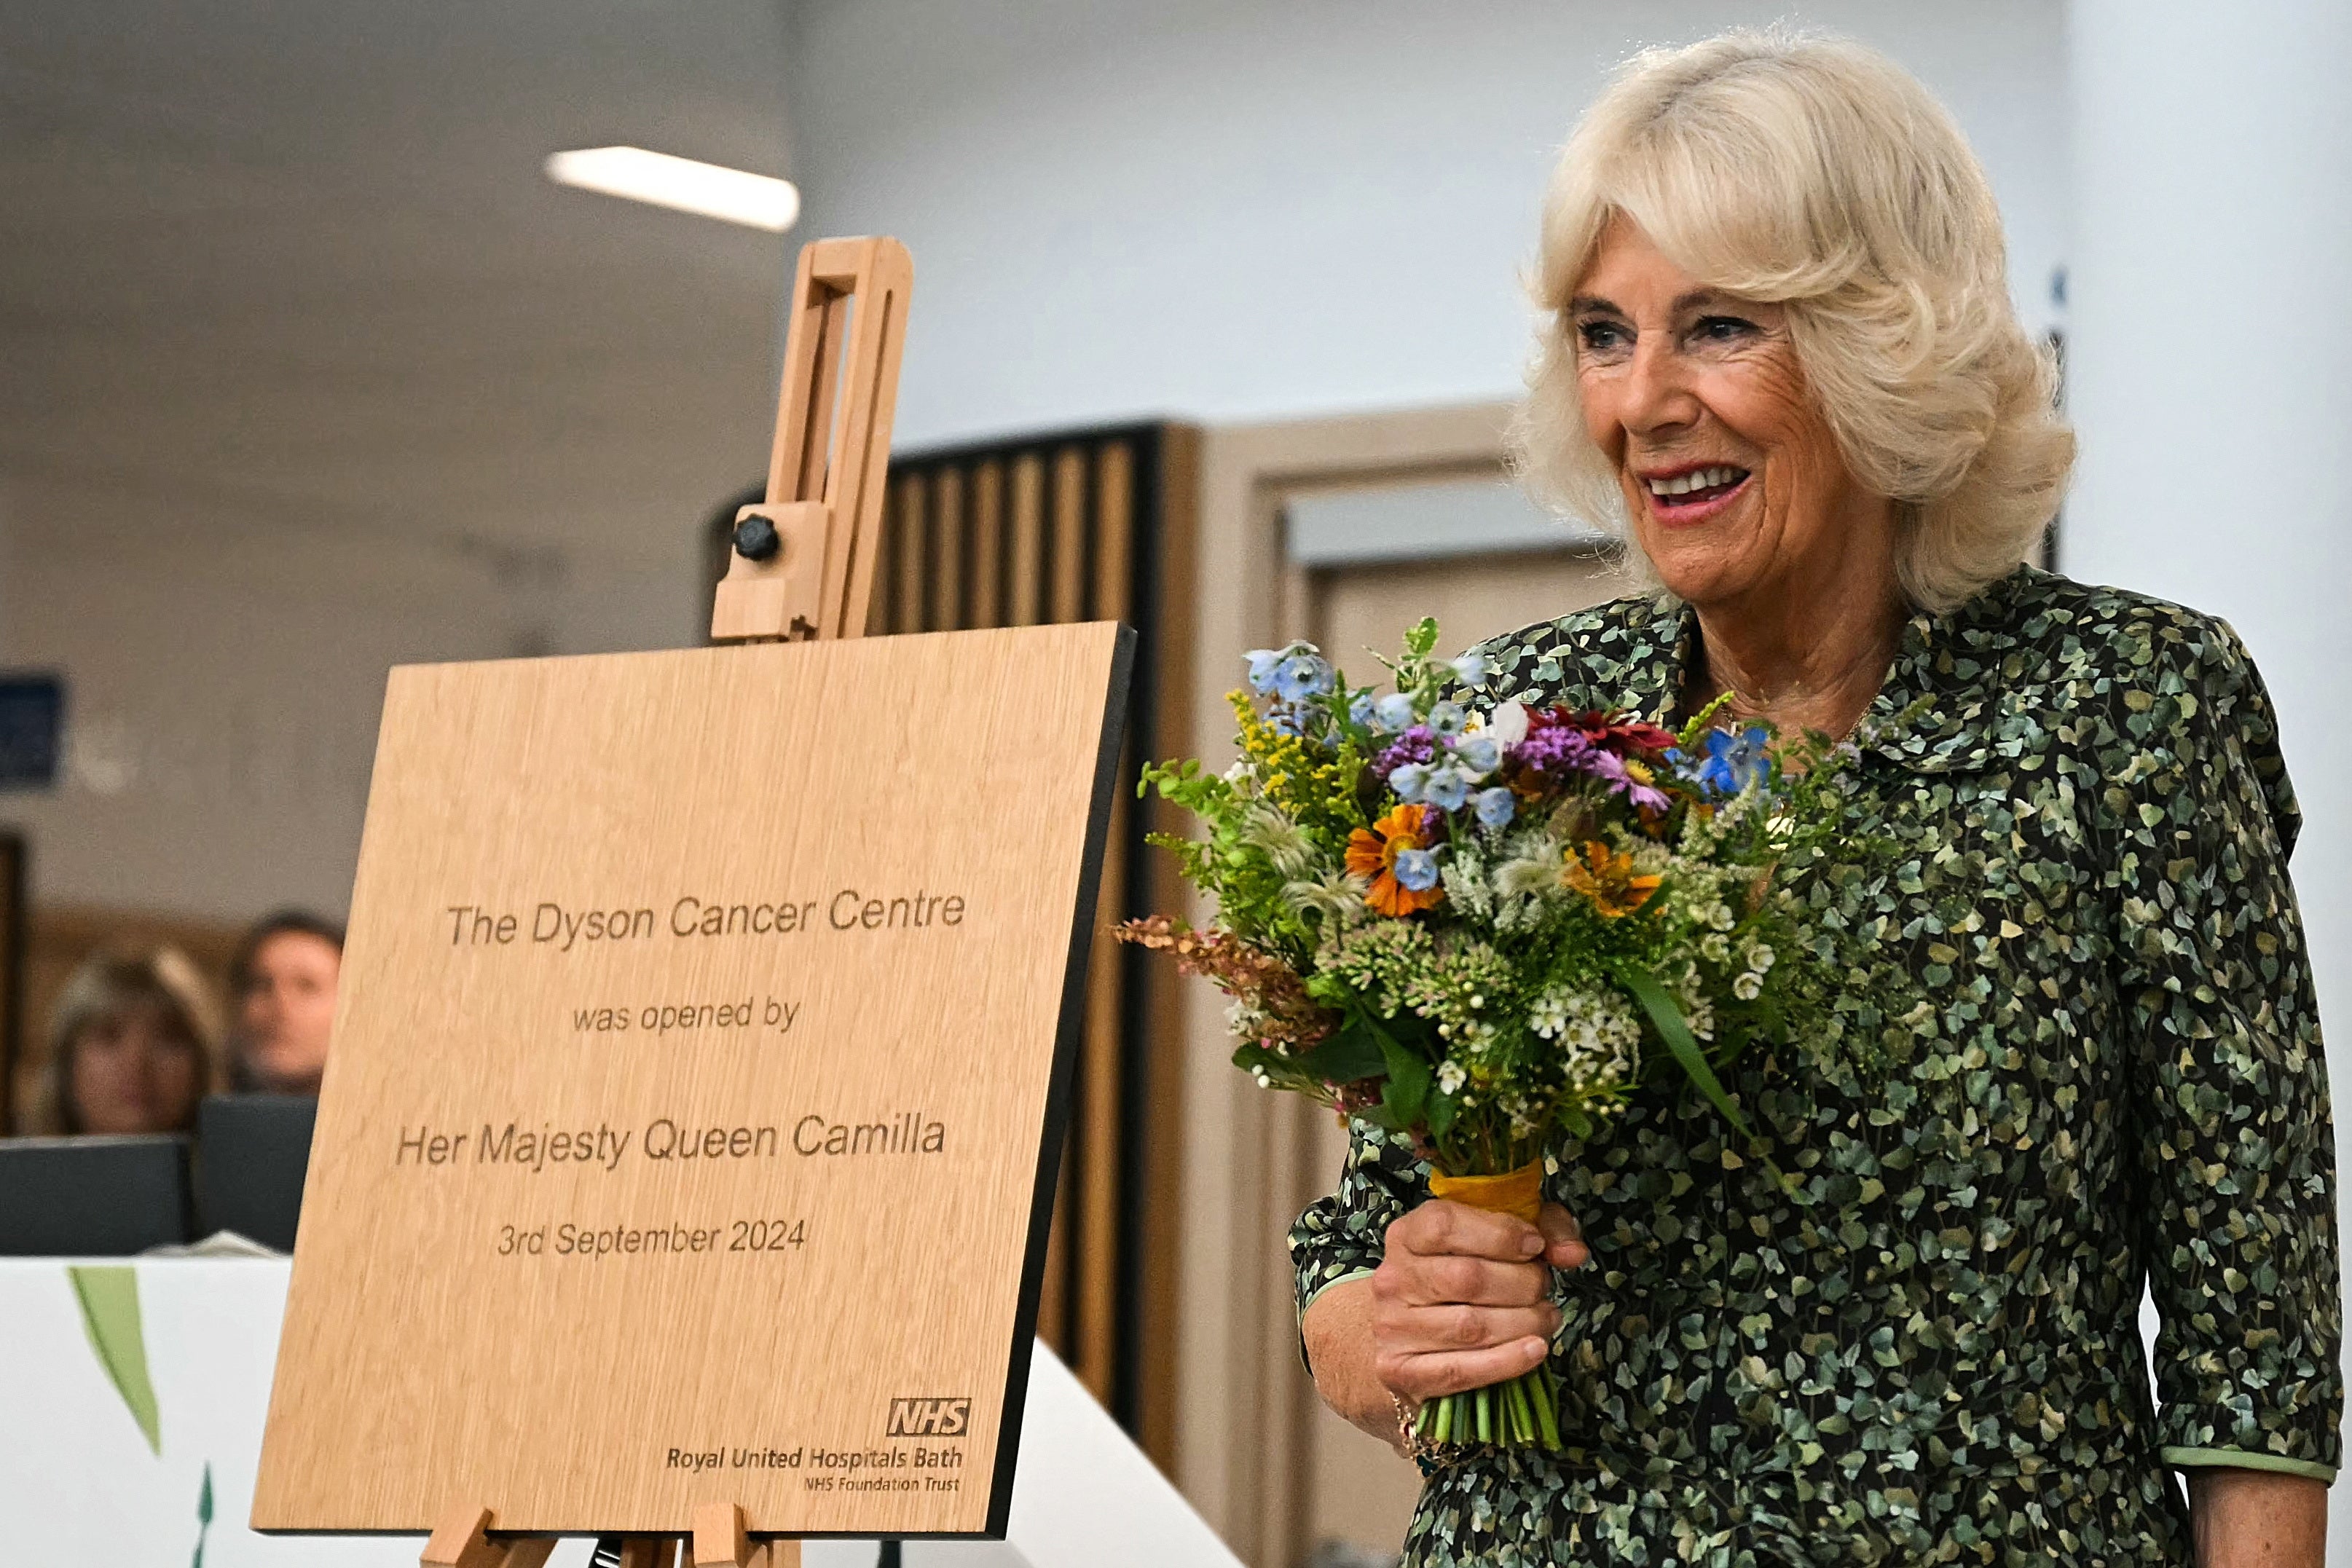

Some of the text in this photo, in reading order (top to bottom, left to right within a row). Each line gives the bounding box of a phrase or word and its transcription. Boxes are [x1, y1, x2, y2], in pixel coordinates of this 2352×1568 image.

[448, 889, 965, 952] The Dyson Cancer Centre
[573, 996, 800, 1036] was opened by
[396, 1112, 945, 1173] Her Majesty Queen Camilla
[497, 1219, 806, 1261] 3rd September 2024
[890, 1400, 967, 1434] NHS
[666, 1446, 962, 1473] Royal United Hospitals Bath
[804, 1476, 959, 1492] NHS Foundation Trust
